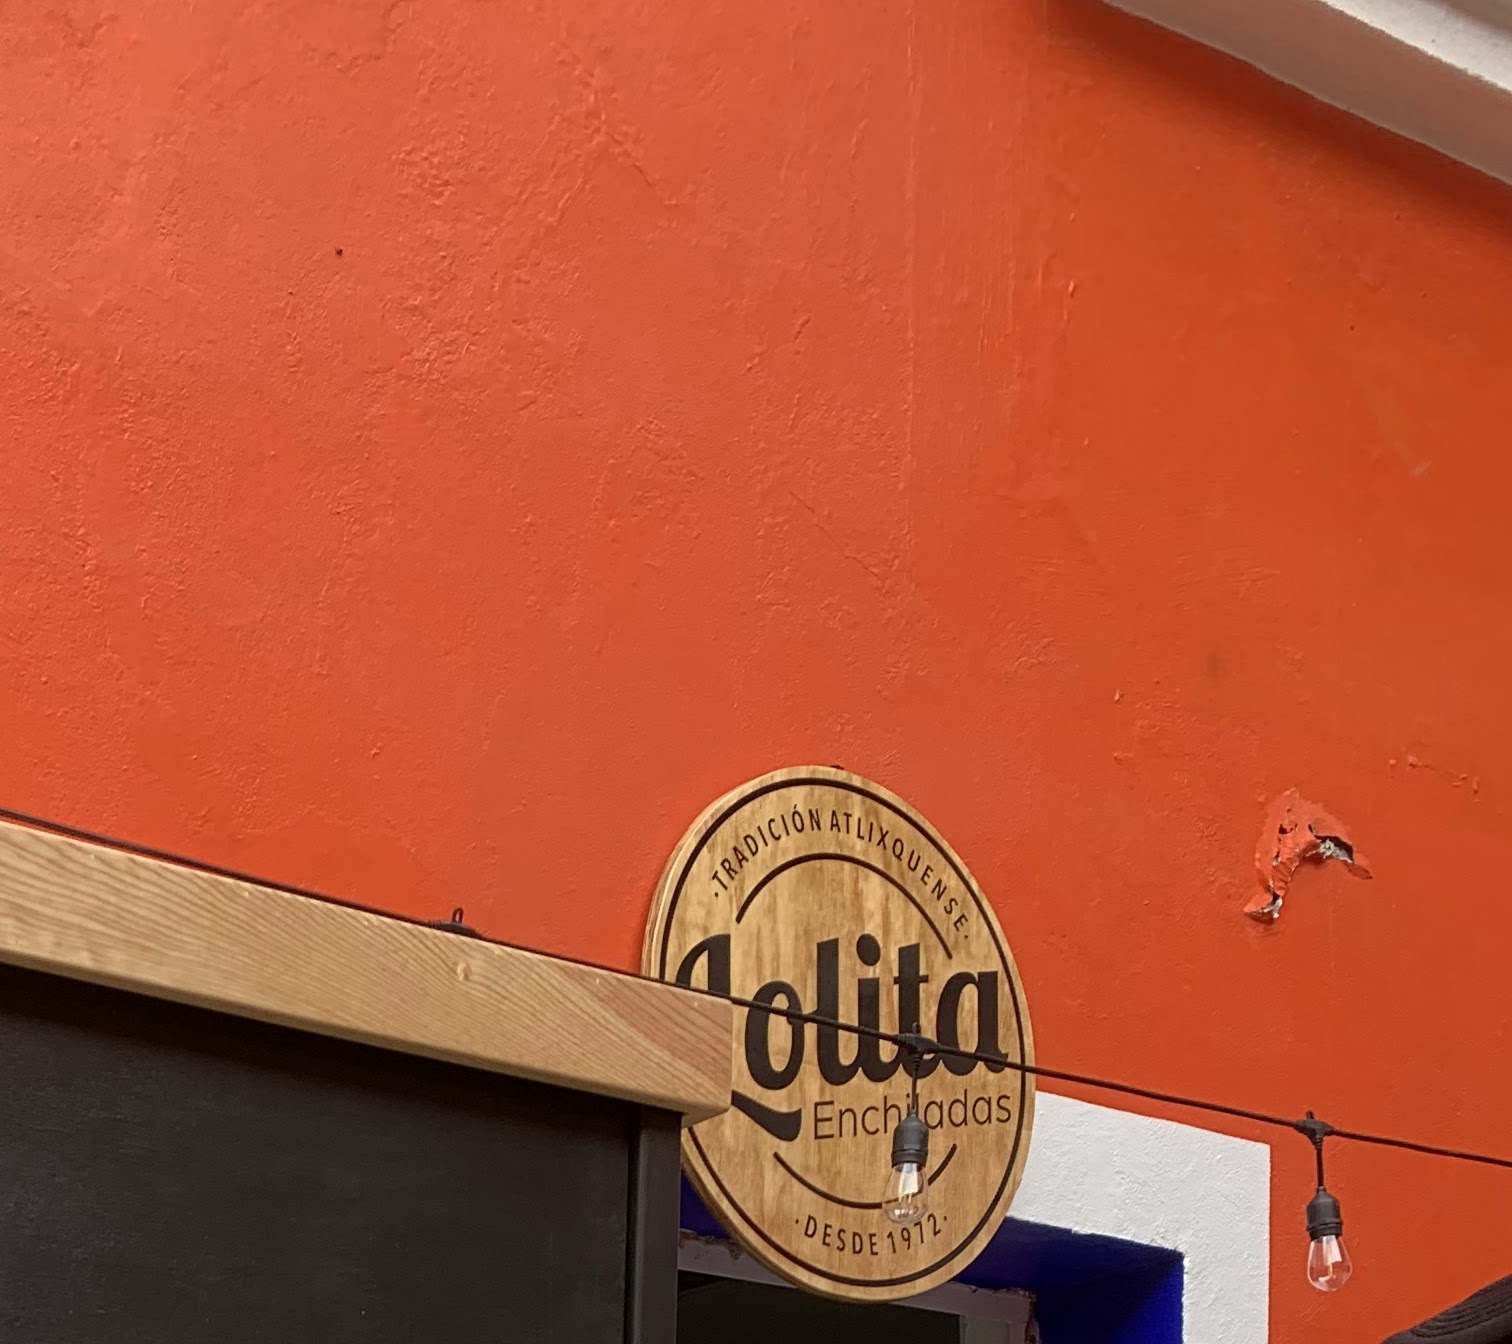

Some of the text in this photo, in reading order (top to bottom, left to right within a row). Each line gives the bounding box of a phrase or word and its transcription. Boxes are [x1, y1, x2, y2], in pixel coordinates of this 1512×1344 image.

[711, 804, 969, 932] TRADICIÓN ATLIXQUENSE
[813, 1088, 1012, 1140] Enchiladas
[804, 1211, 942, 1256] DESDE 1972
